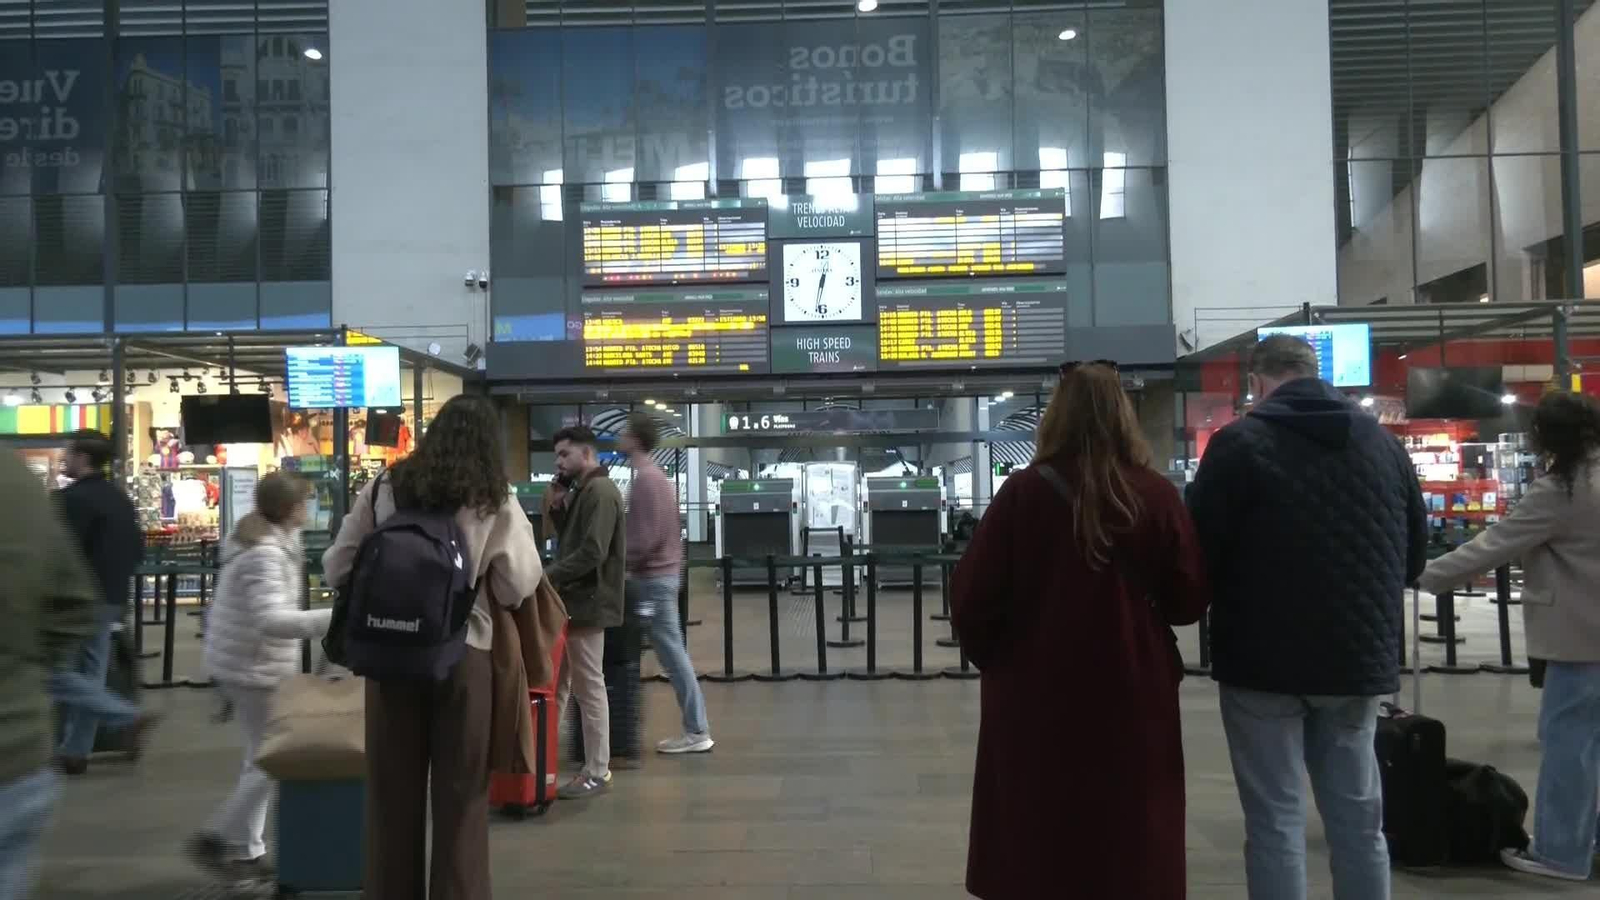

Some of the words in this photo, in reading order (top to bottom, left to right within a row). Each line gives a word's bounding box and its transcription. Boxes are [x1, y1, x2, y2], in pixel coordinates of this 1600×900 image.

[797, 215, 845, 228] VELOCIDAD
[815, 250, 829, 259] 12
[790, 278, 799, 288] 9
[845, 276, 854, 286] 3
[818, 304, 828, 314] 6
[796, 337, 820, 350] HIGH
[822, 336, 851, 350] SPEED
[808, 351, 840, 364] TRAINS
[742, 415, 770, 430] 1.6
[367, 613, 420, 633] hummel
